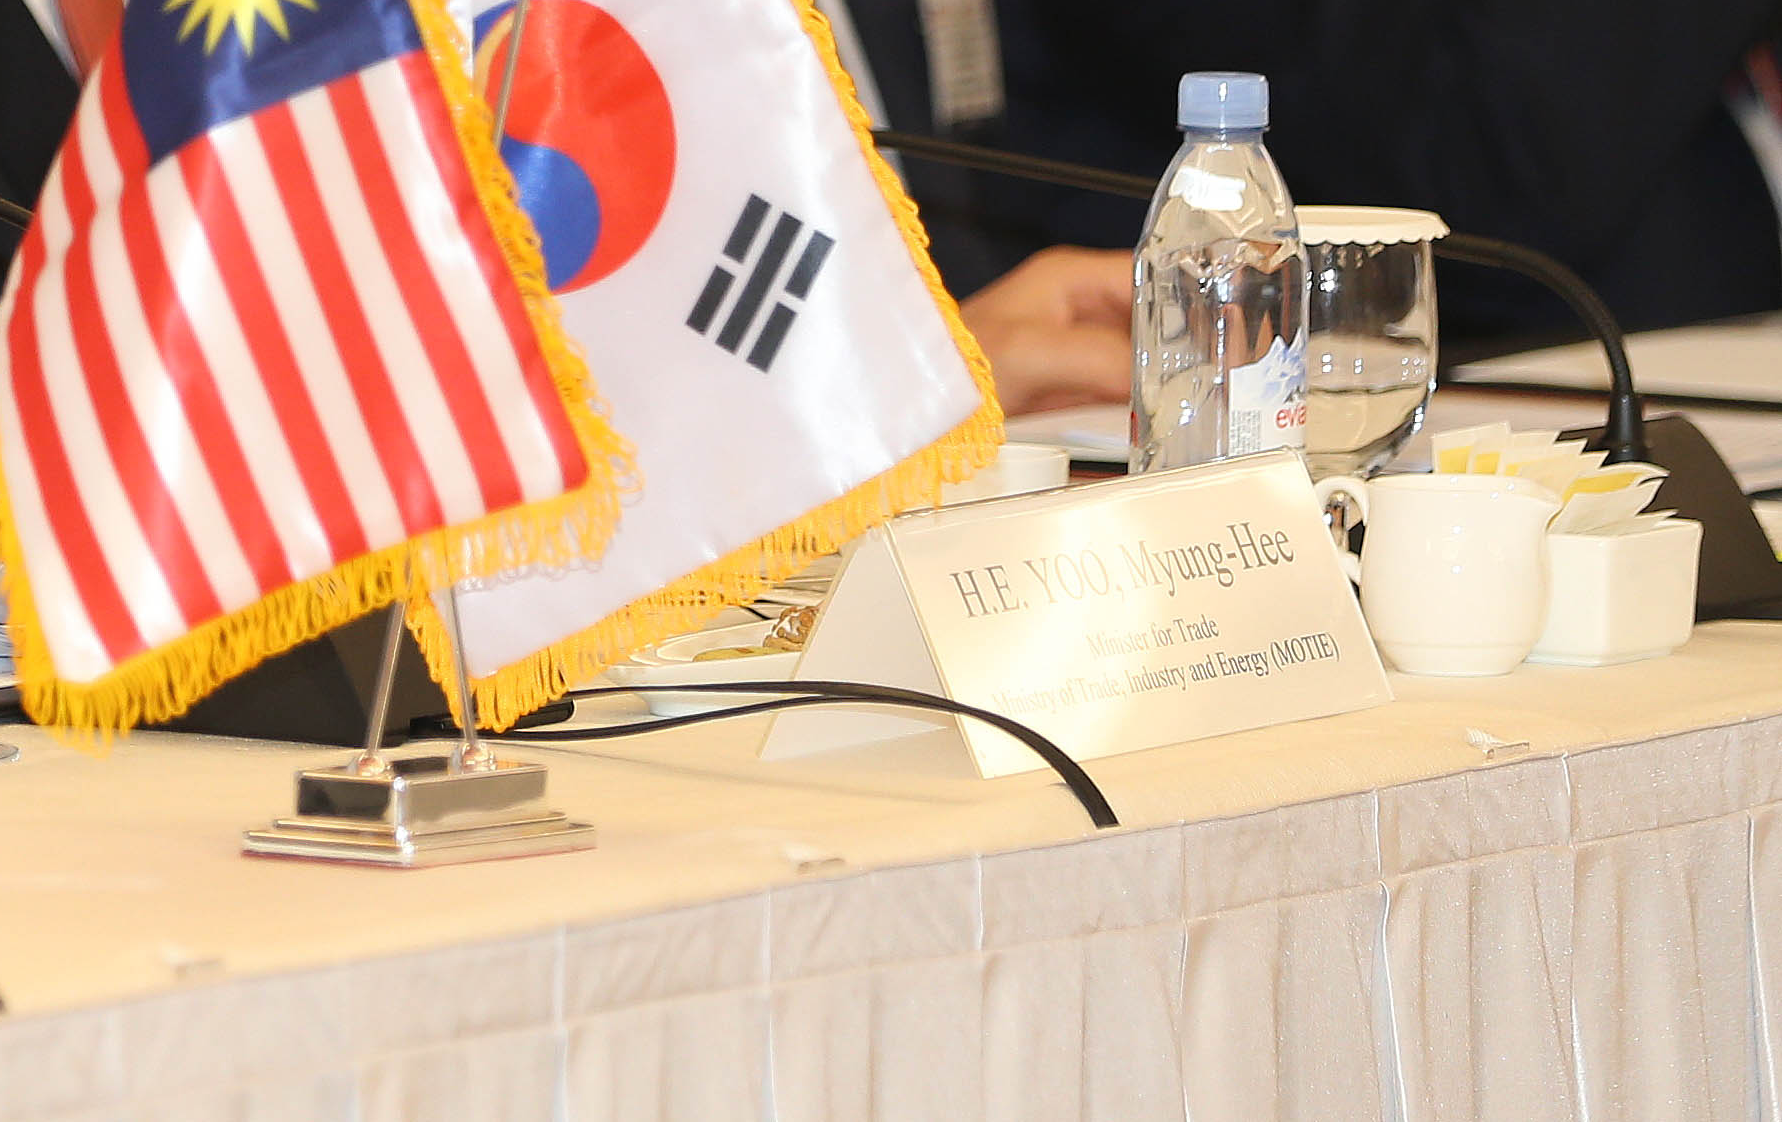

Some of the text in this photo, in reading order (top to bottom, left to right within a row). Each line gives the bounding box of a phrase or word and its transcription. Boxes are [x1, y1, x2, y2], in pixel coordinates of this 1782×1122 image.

[950, 522, 1295, 618] H.E. YOO, Myung-Hee
[1059, 677, 1076, 707] of
[1124, 665, 1189, 691] Industry
[1189, 654, 1217, 682] and
[1216, 648, 1271, 677] Energy
[1270, 632, 1340, 672] (MOTIE)
[1086, 613, 1219, 659] Minister for Trade
